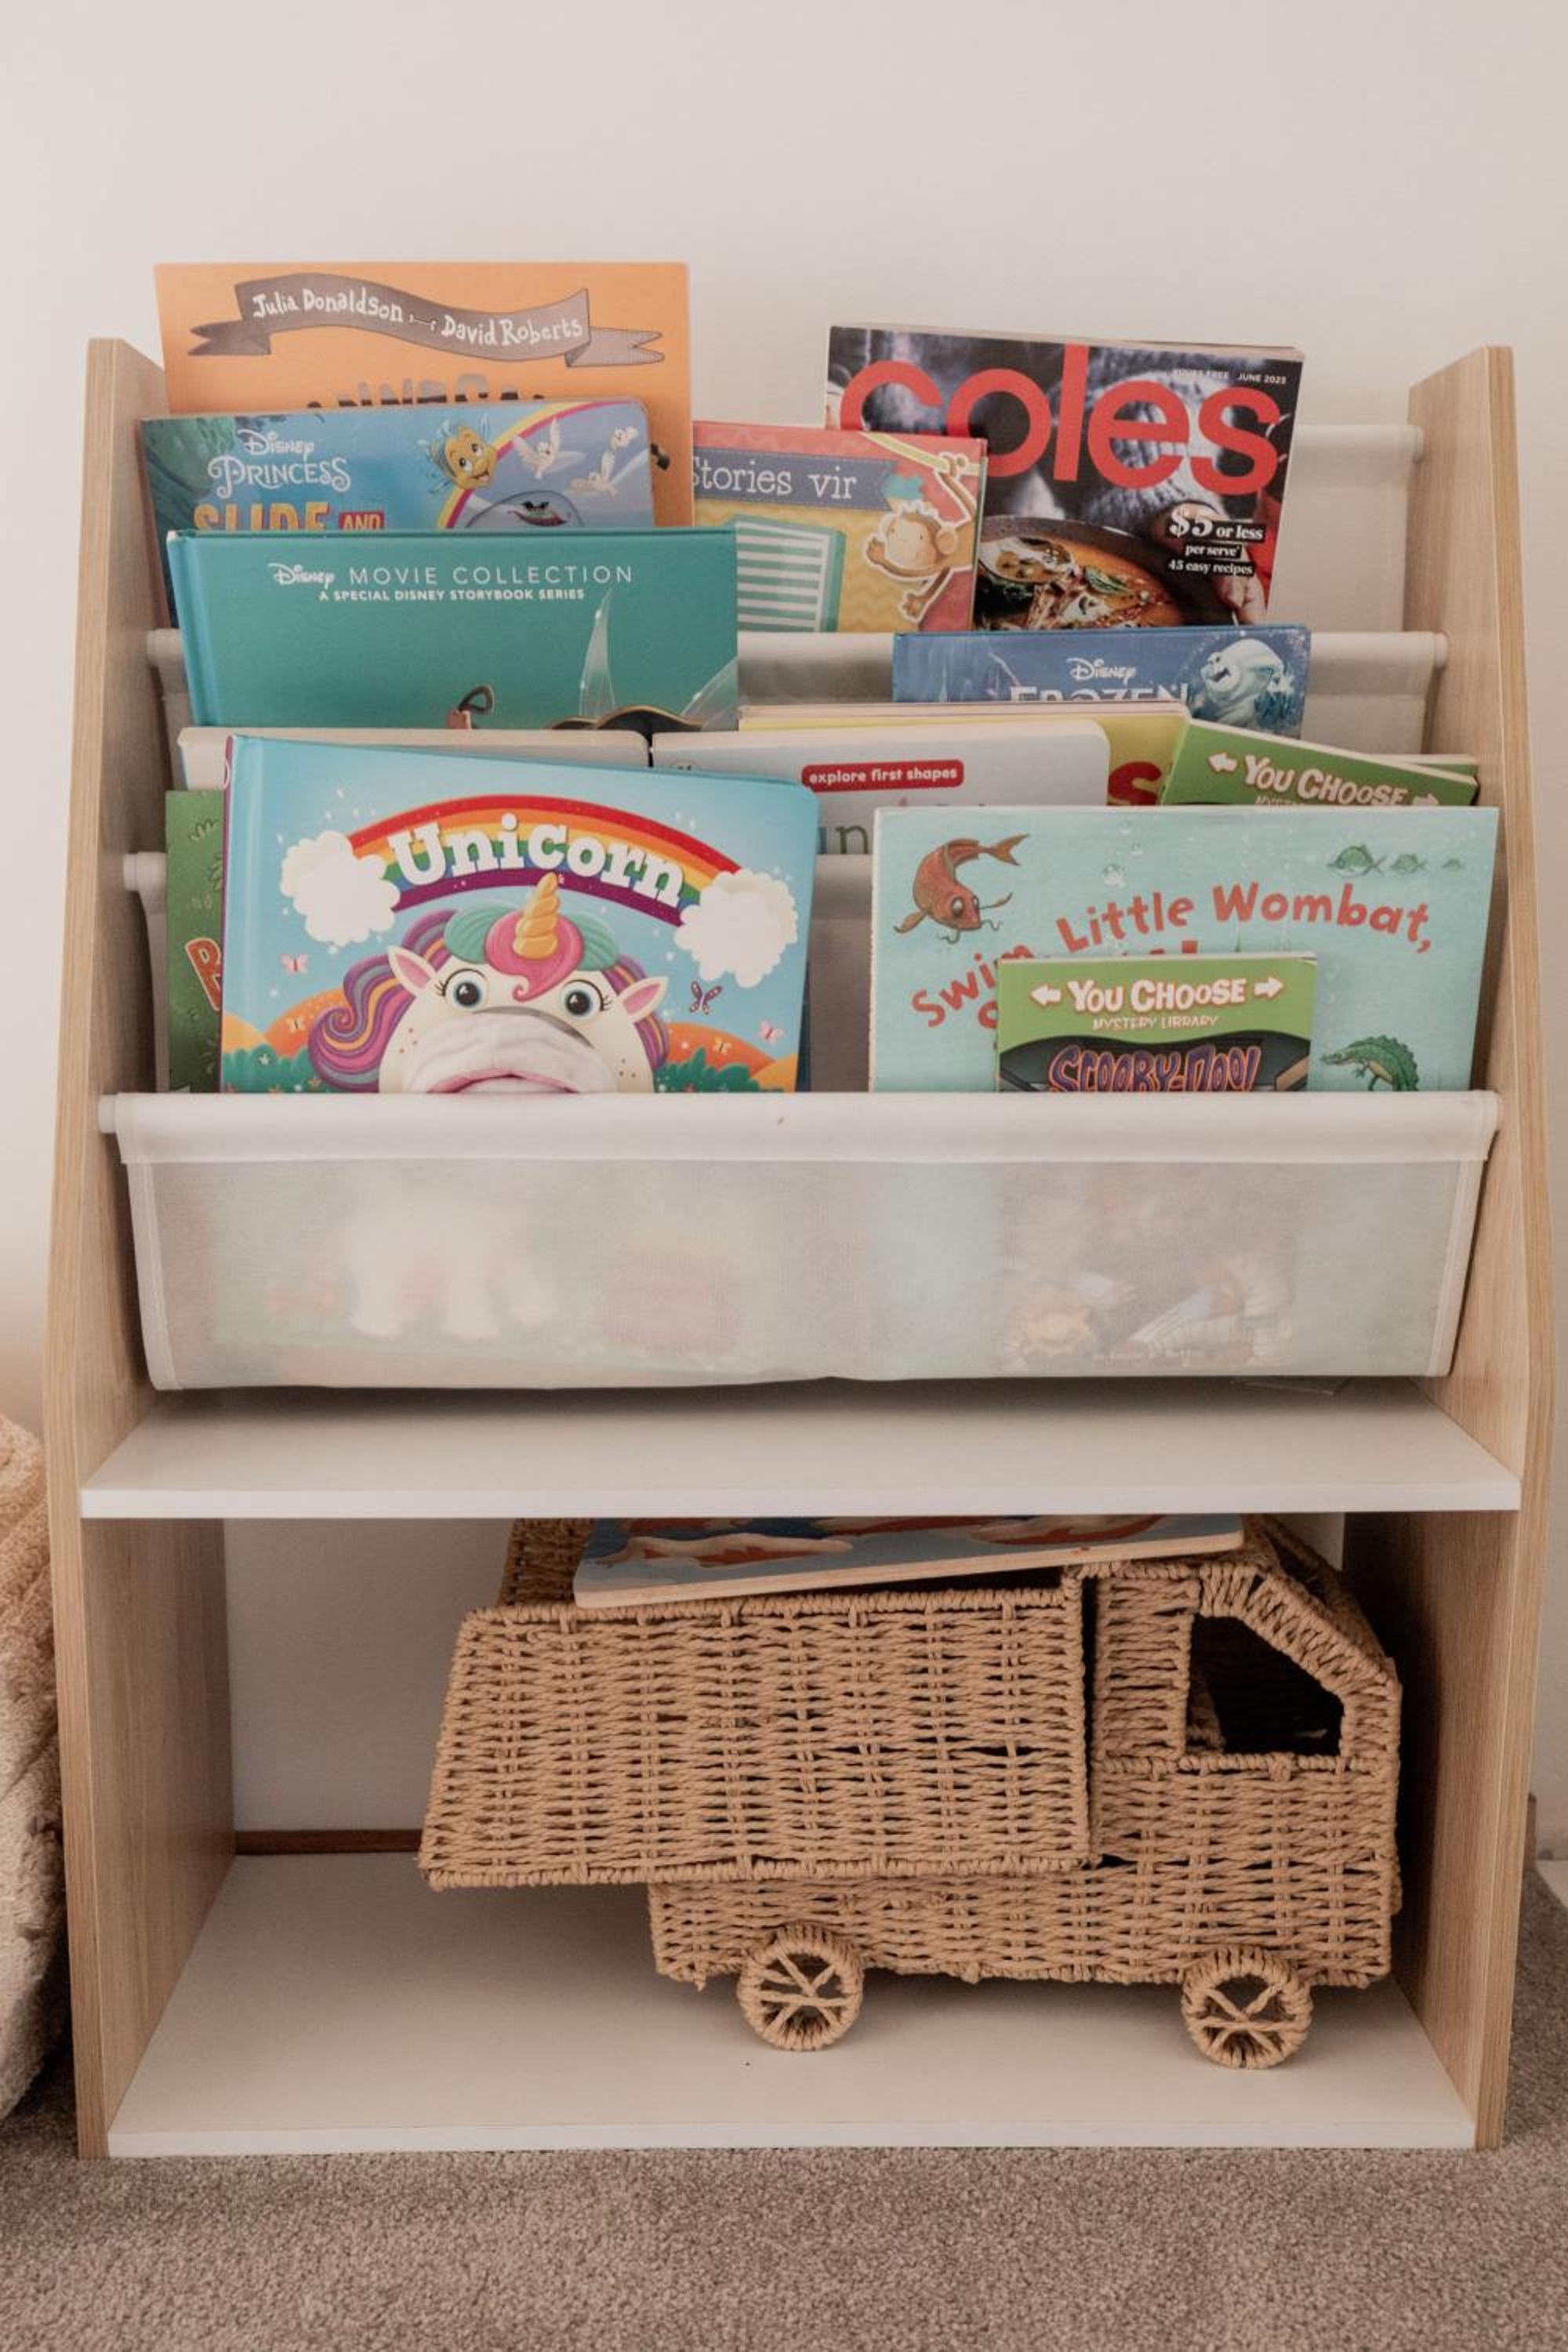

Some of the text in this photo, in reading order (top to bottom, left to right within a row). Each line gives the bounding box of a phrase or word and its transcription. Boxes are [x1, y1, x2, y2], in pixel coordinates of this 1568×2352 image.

[252, 286, 404, 323] Julia Donaldson
[441, 314, 583, 347] David Roberts
[1238, 372, 1261, 383] JUNE
[840, 343, 1281, 495] coles
[207, 455, 351, 499] PRINCESS
[808, 466, 857, 499] vir
[1169, 506, 1263, 541] $5 or less
[1168, 558, 1253, 575] 45 easy recipes
[1185, 543, 1204, 557] per
[349, 567, 438, 585] MOVIE
[452, 565, 632, 584] COLLECTION
[318, 588, 585, 602] A SPECIAL DISNEY STORYBOOK SERIES
[808, 768, 958, 786] explore first shapes
[1245, 753, 1409, 805] YOU CHOOSE
[387, 812, 684, 907] Unicorn
[1056, 891, 1195, 953] Little
[1212, 881, 1431, 954] Wombat,
[1067, 978, 1248, 1014] YOU CHOOSE
[1092, 1014, 1220, 1030] MYSTERY LIBRARY
